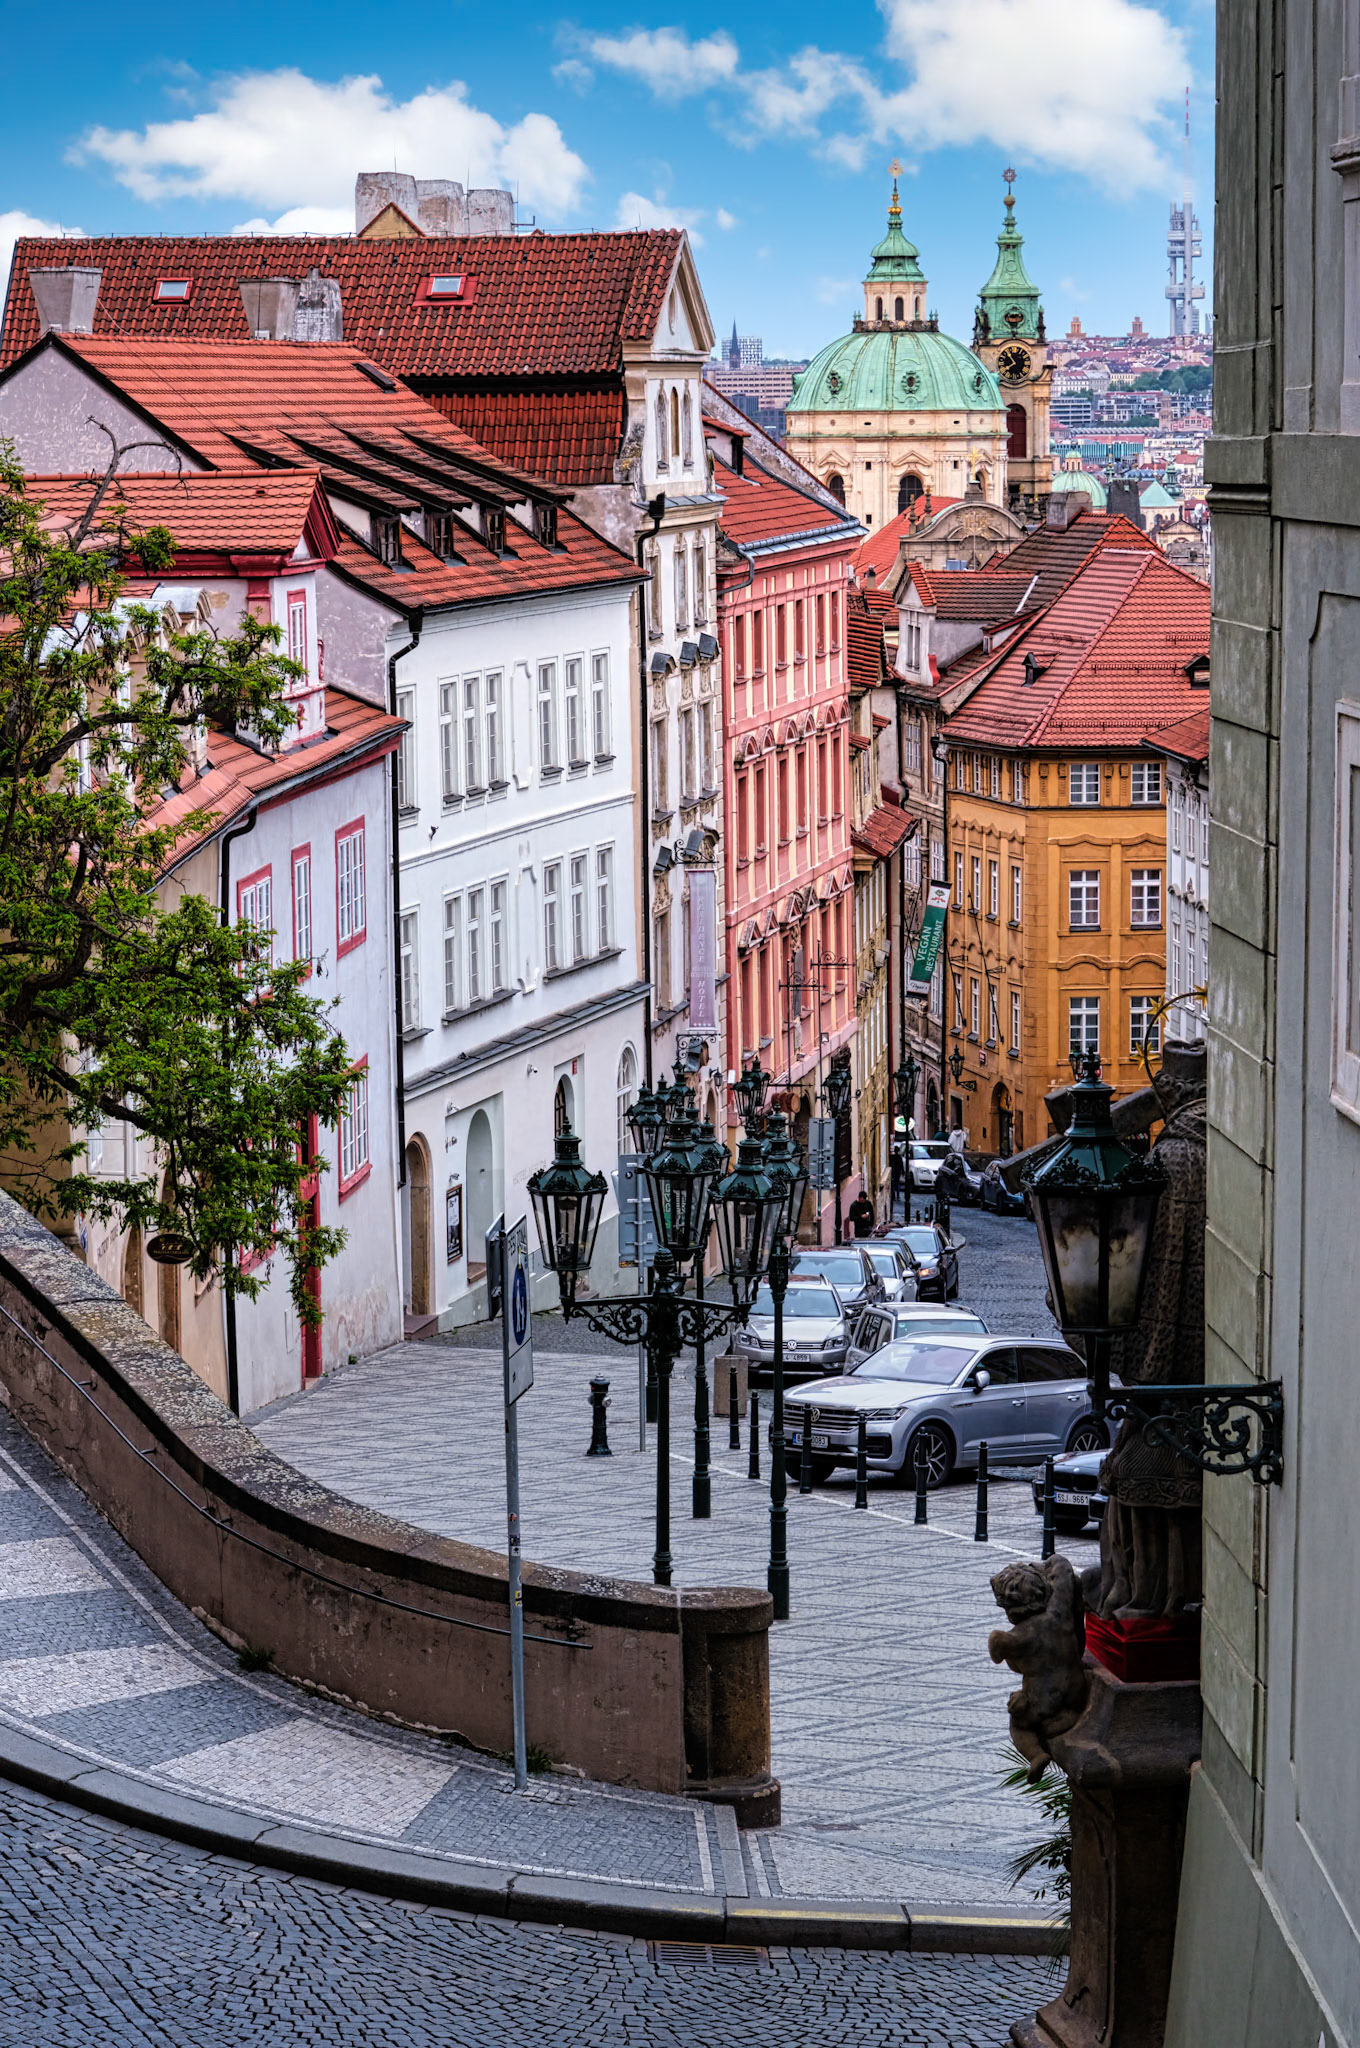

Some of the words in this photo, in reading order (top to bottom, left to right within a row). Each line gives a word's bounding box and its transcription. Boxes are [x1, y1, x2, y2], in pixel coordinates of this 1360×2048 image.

[916, 926, 932, 961] VEGAN
[925, 919, 943, 972] RESTAURANT
[697, 981, 706, 1017] HOTEL
[1057, 1493, 1069, 1503] 5SJ
